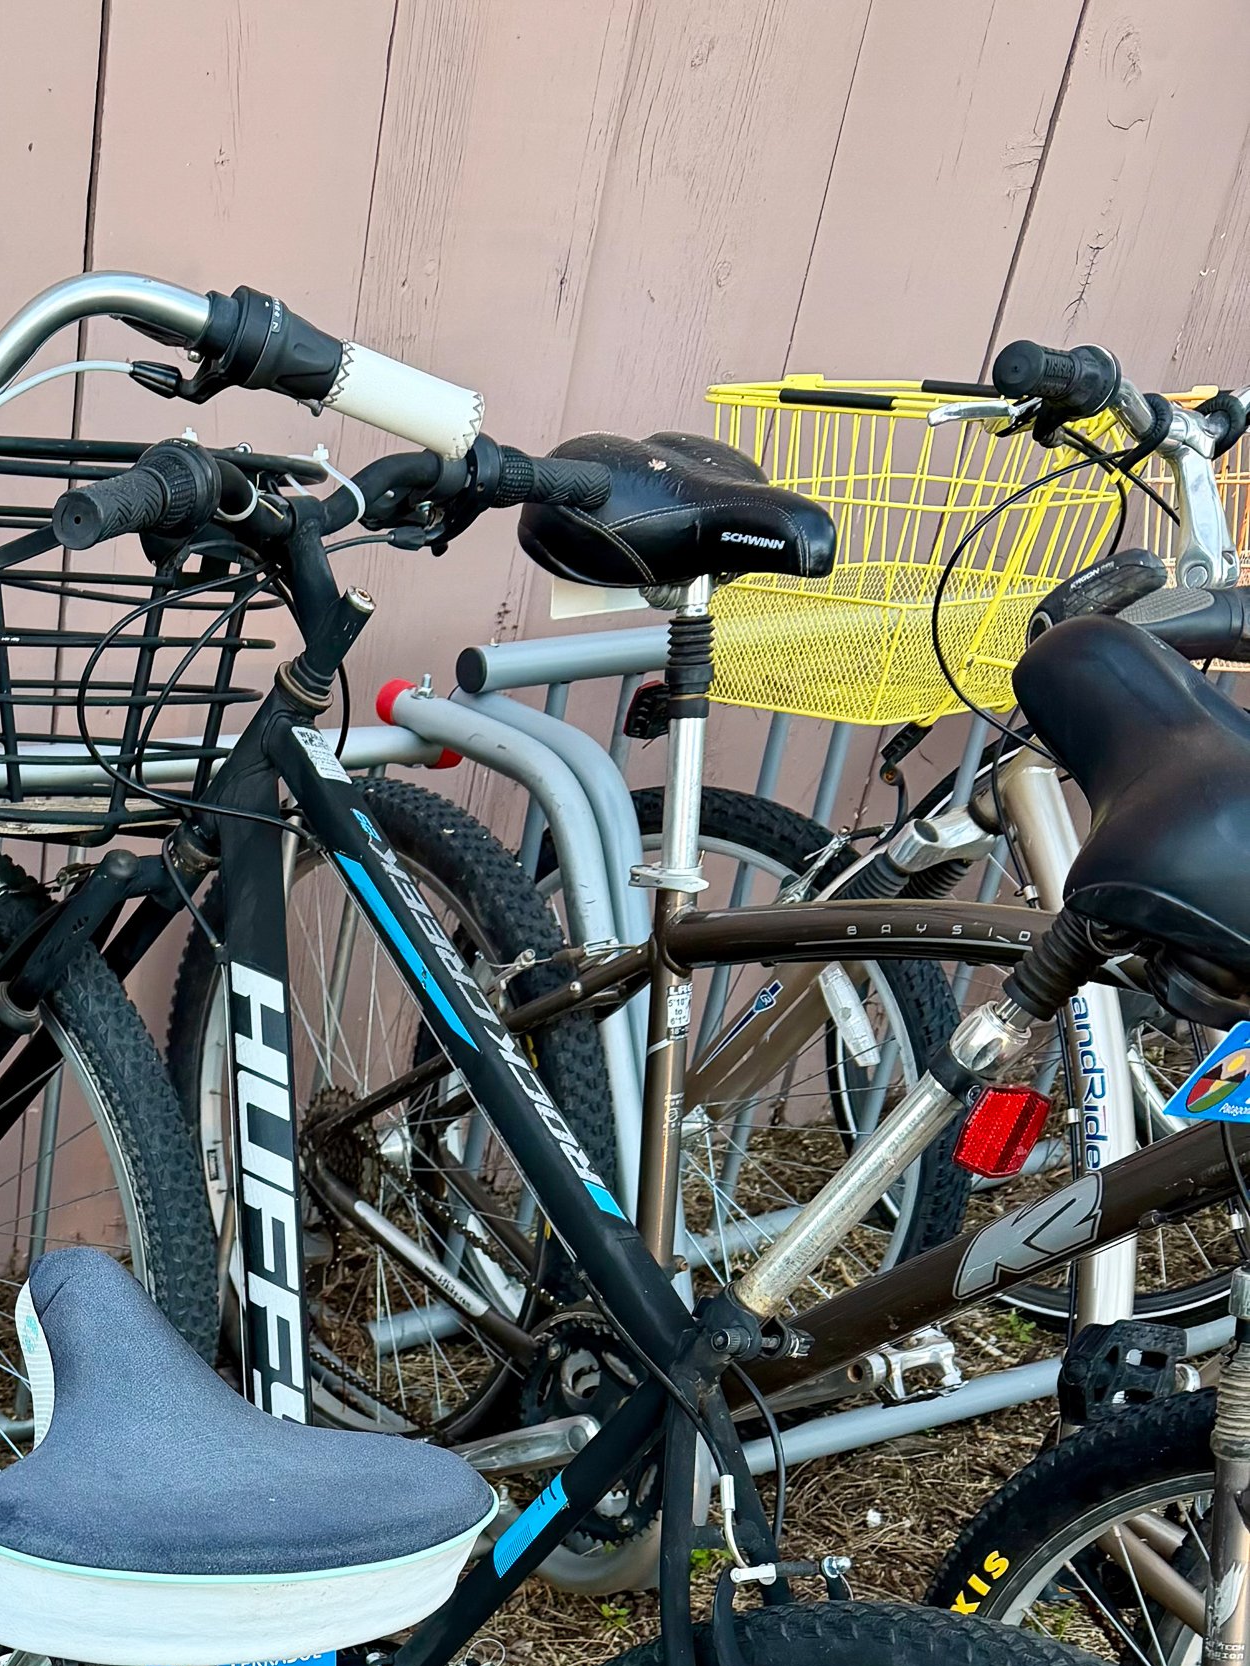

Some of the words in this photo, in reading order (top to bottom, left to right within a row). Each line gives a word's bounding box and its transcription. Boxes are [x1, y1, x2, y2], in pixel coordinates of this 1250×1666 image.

[720, 531, 785, 550] SCHWINN
[368, 846, 501, 1025] CREEK
[483, 1025, 605, 1190] ROCK
[952, 1170, 1103, 1300] K2
